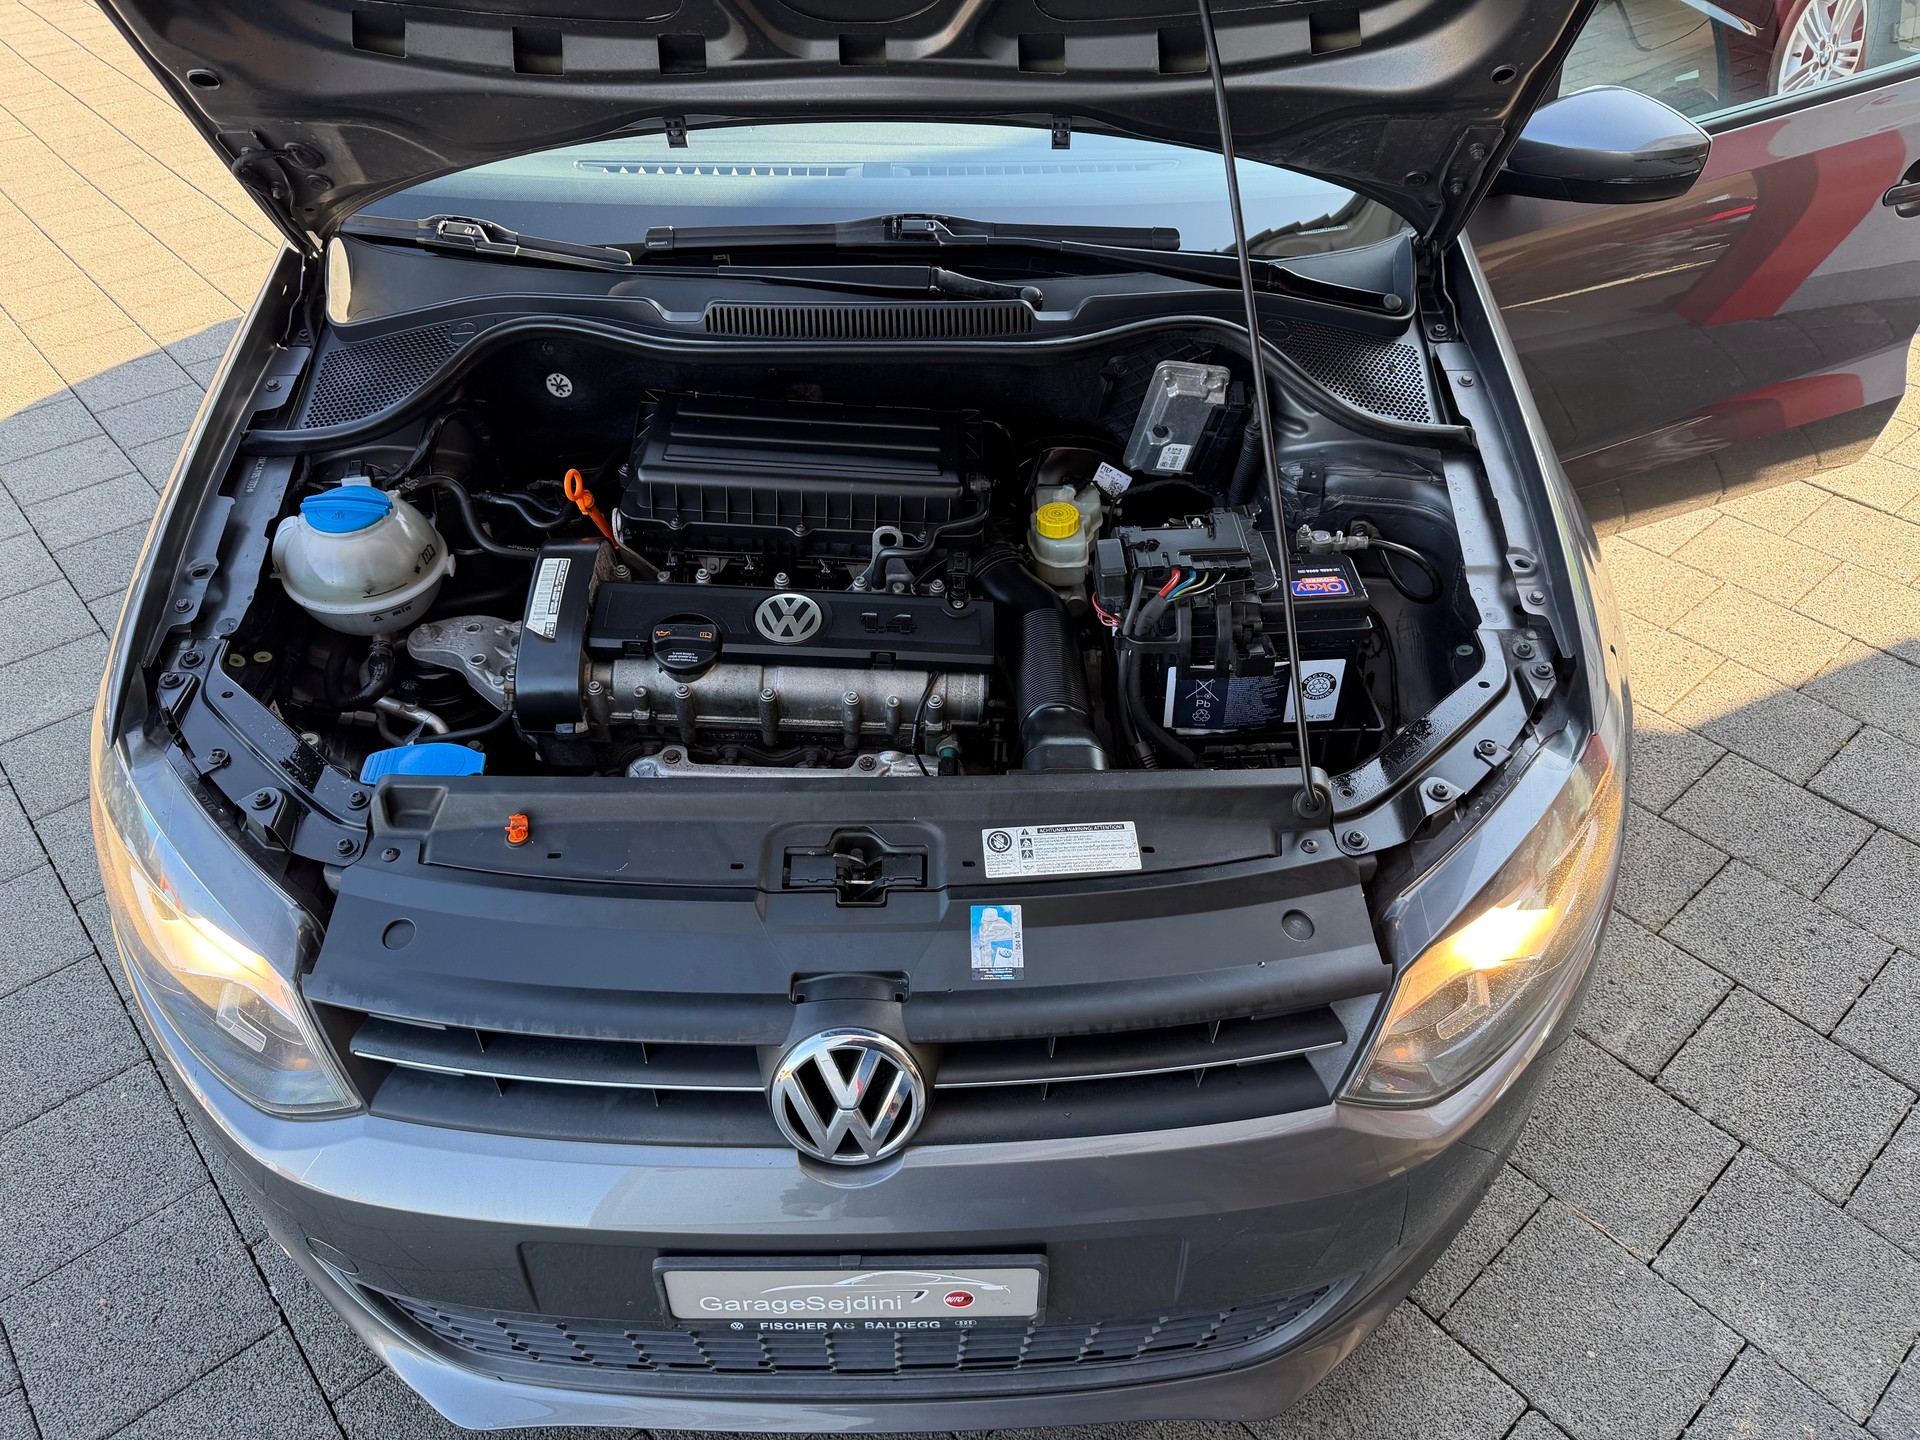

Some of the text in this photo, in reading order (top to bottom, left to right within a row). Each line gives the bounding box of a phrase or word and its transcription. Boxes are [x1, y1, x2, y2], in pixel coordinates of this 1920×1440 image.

[1296, 582, 1342, 592] Okay
[392, 605, 412, 616] min
[860, 611, 918, 634] 1.4
[1303, 673, 1335, 685] RECYCLE
[1195, 699, 1211, 708] Pb
[699, 1293, 903, 1314] GarageSejdini
[760, 1322, 828, 1330] FISCHER
[865, 1321, 941, 1329] BALDEGG
